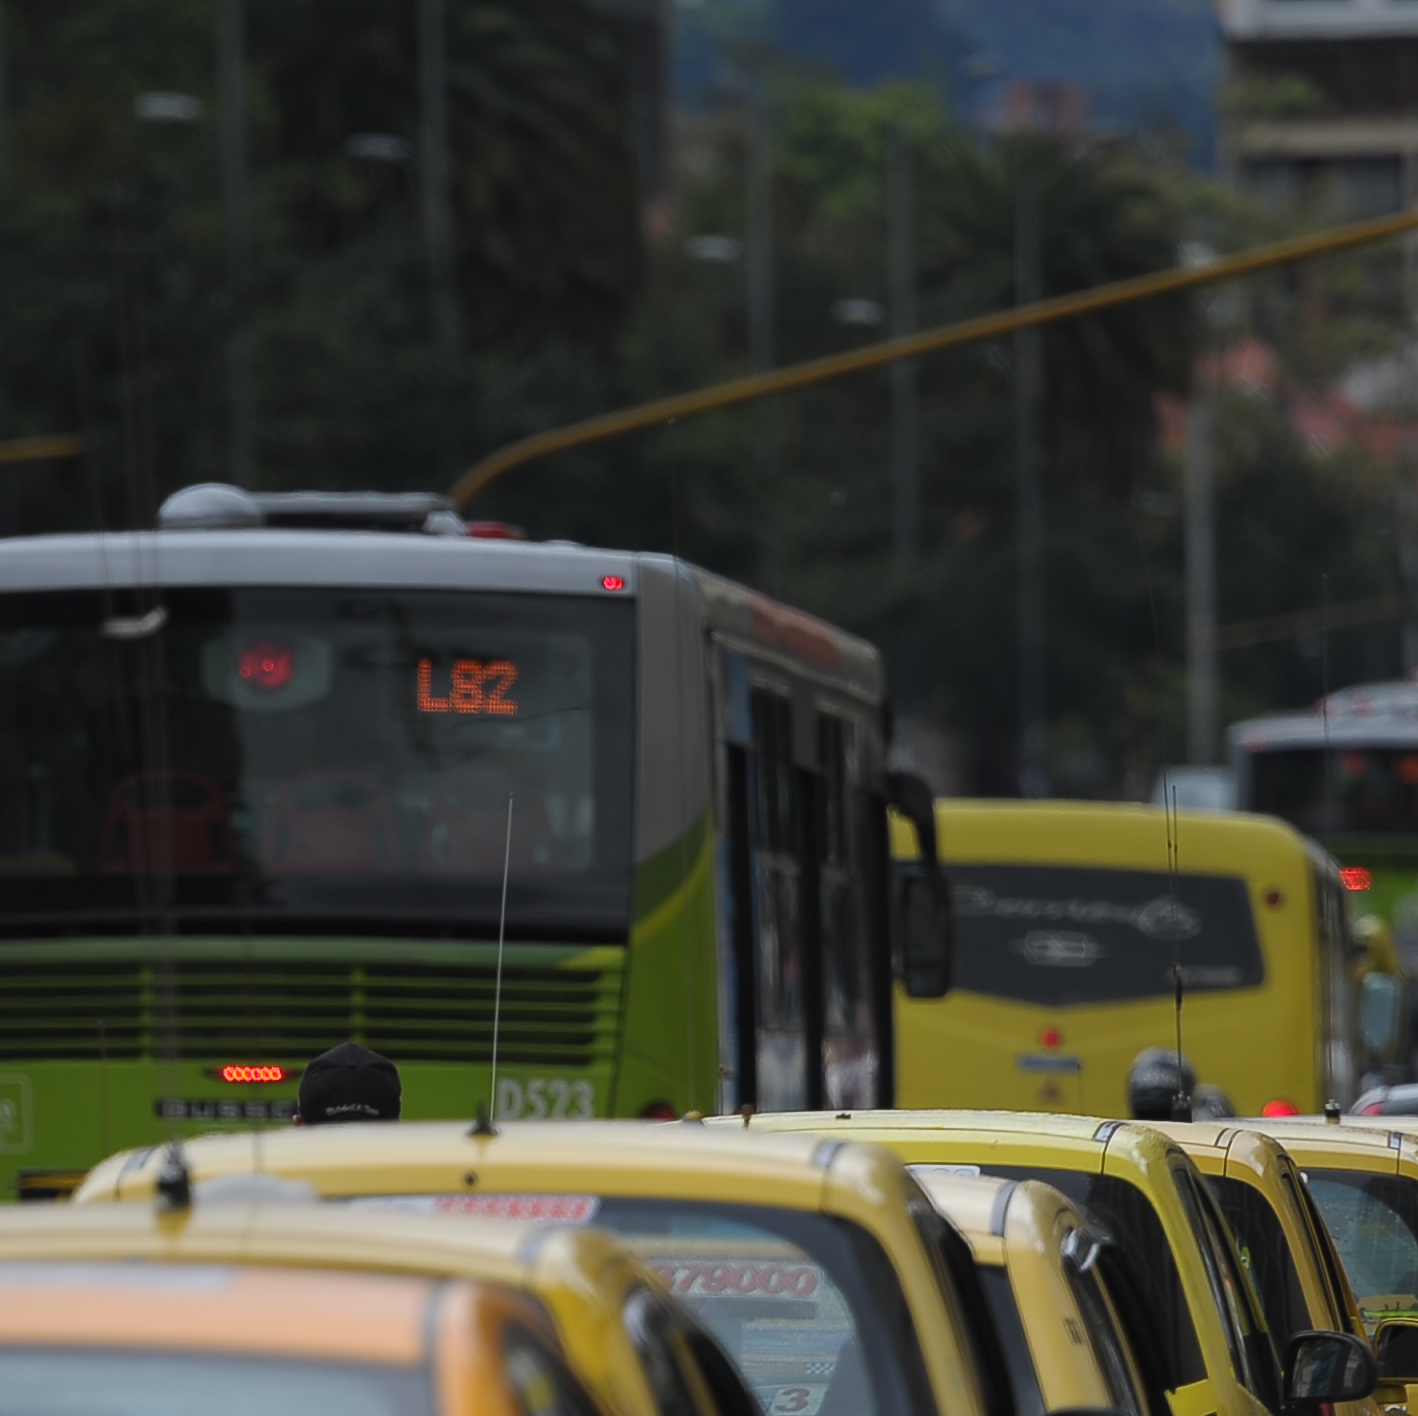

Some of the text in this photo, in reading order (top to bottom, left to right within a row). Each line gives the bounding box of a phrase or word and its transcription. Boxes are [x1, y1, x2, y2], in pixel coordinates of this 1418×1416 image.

[417, 657, 518, 715] L82
[496, 1077, 594, 1120] D523
[776, 1388, 810, 1412] 3
